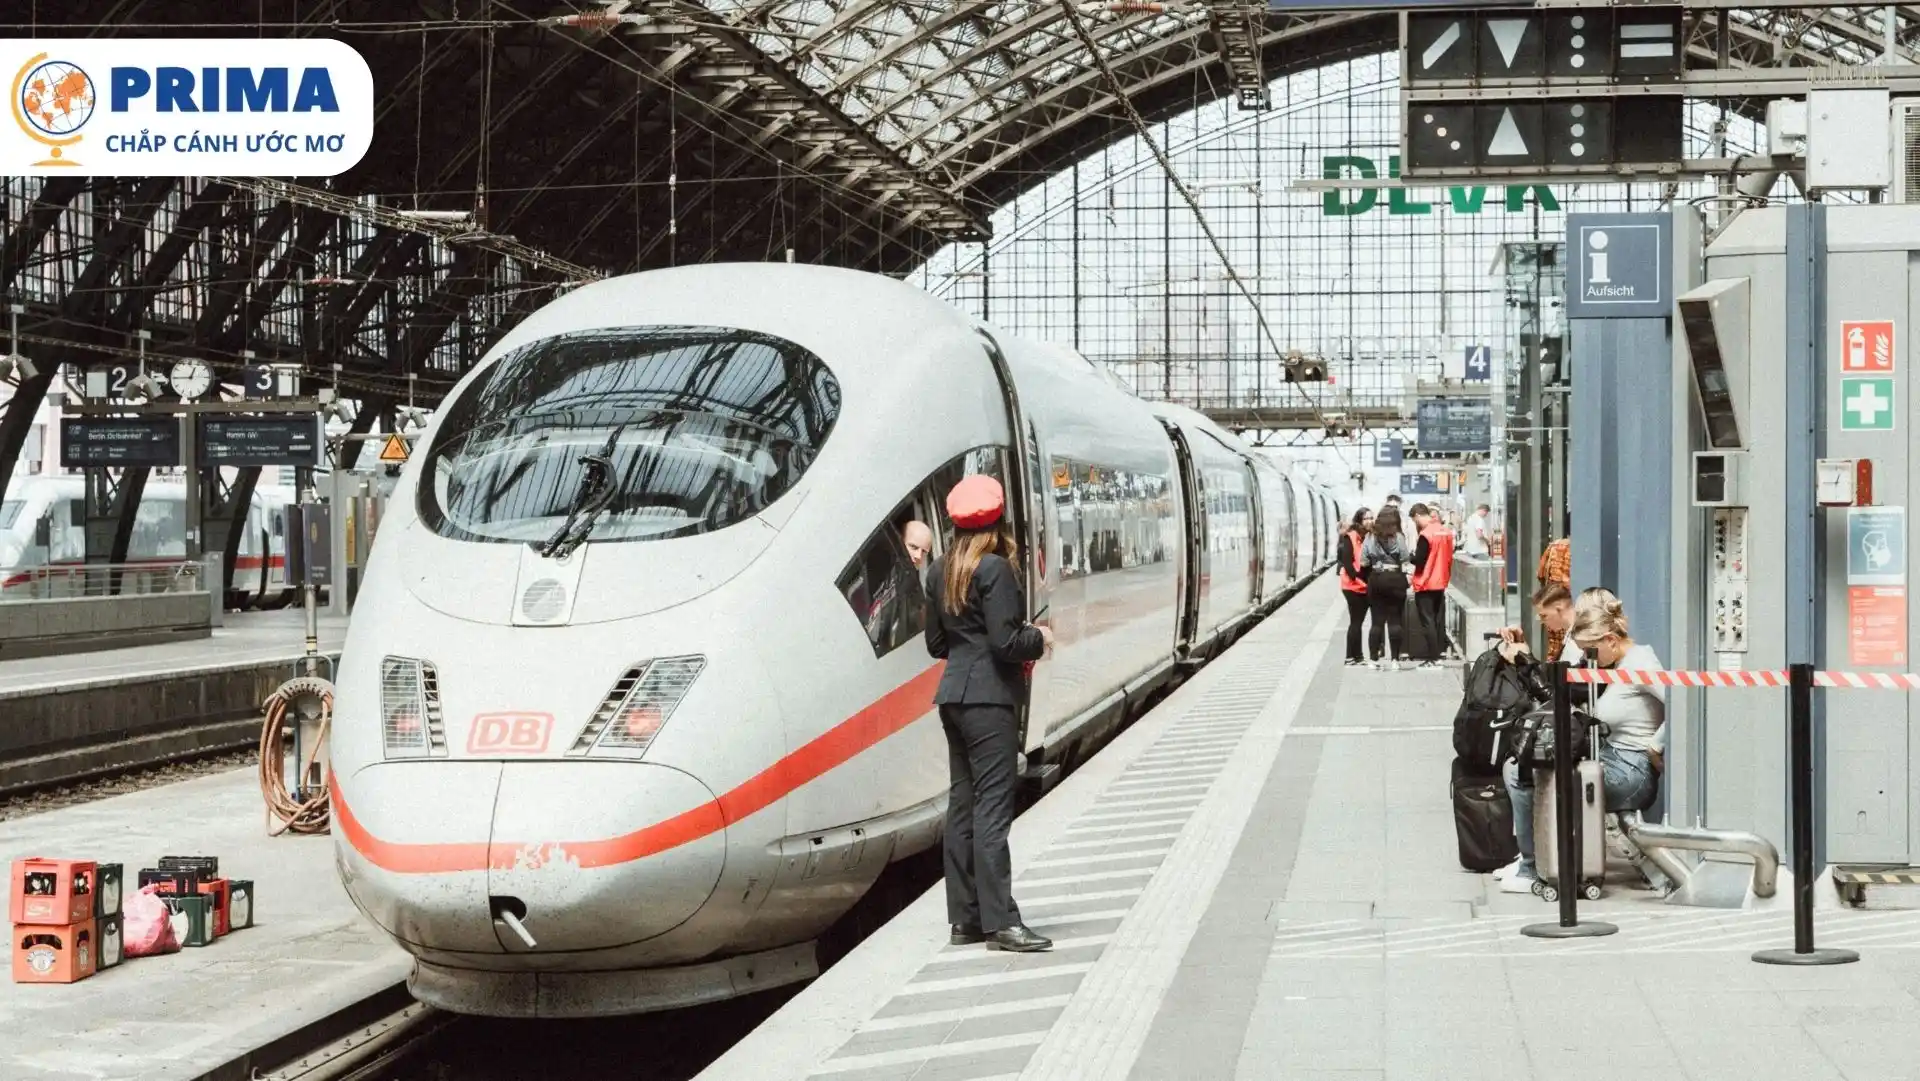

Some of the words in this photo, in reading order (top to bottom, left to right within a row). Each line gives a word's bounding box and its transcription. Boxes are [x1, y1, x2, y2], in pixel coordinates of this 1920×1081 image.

[1586, 285, 1635, 296] Aufsicht
[1469, 346, 1486, 372] 4
[112, 367, 127, 392] 2
[256, 365, 272, 390] 3
[1376, 439, 1391, 461] E
[1410, 475, 1420, 489] F
[478, 718, 540, 746] DB
